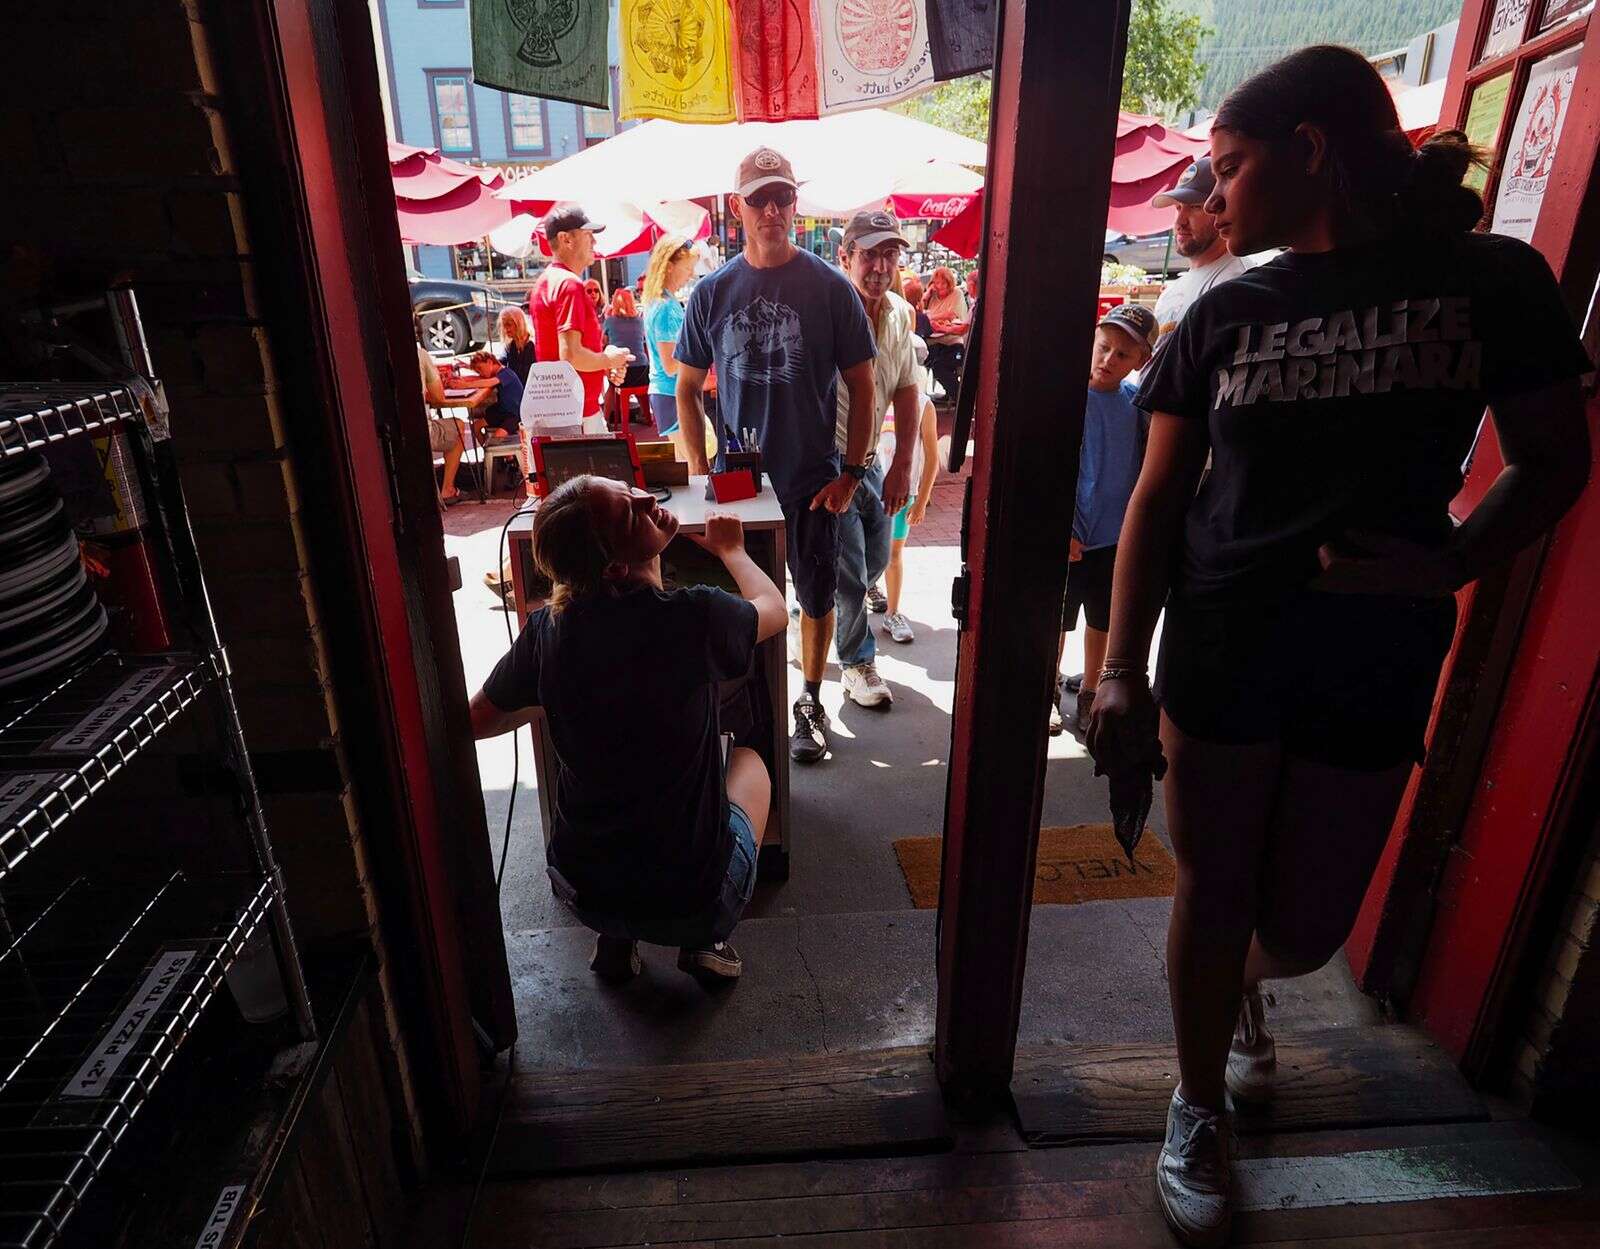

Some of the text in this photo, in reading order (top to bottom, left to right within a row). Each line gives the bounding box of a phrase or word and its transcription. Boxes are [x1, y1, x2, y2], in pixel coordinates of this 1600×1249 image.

[918, 196, 970, 217] Coca-Col
[116, 668, 164, 703] PLATES
[104, 1008, 150, 1055] PIZZA
[142, 958, 187, 1005] TRAYS
[211, 1190, 238, 1227] TUB
